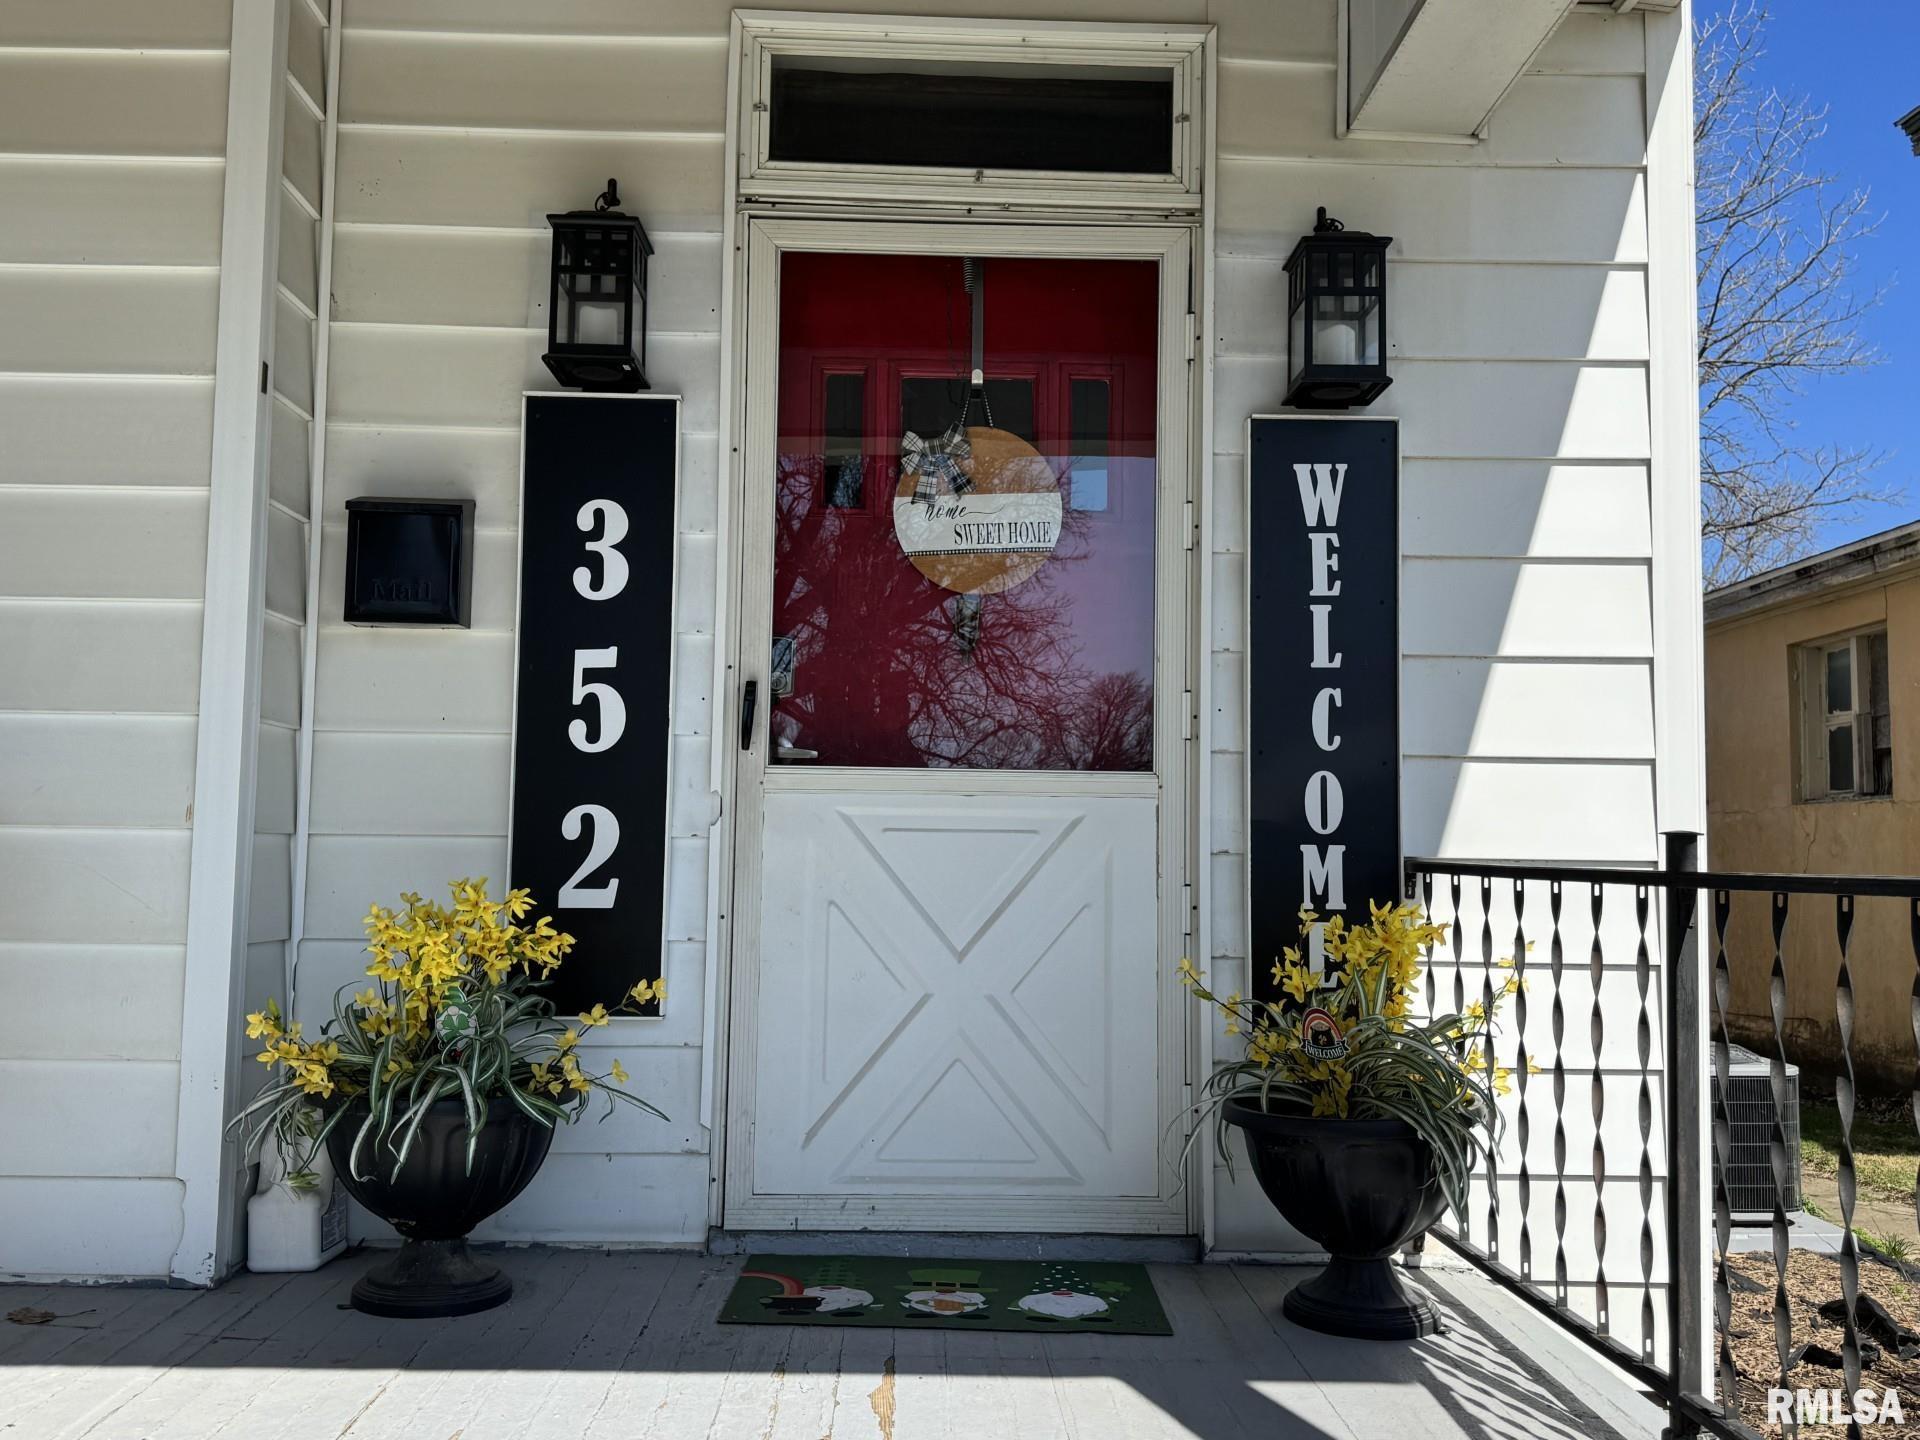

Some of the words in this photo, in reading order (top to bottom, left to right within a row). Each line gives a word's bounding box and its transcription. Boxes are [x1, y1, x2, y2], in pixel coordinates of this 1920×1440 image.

[954, 523, 1005, 545] SWEET
[1008, 521, 1051, 544] HOME
[558, 499, 630, 908] 352
[1308, 1045, 1344, 1058] WELCOME
